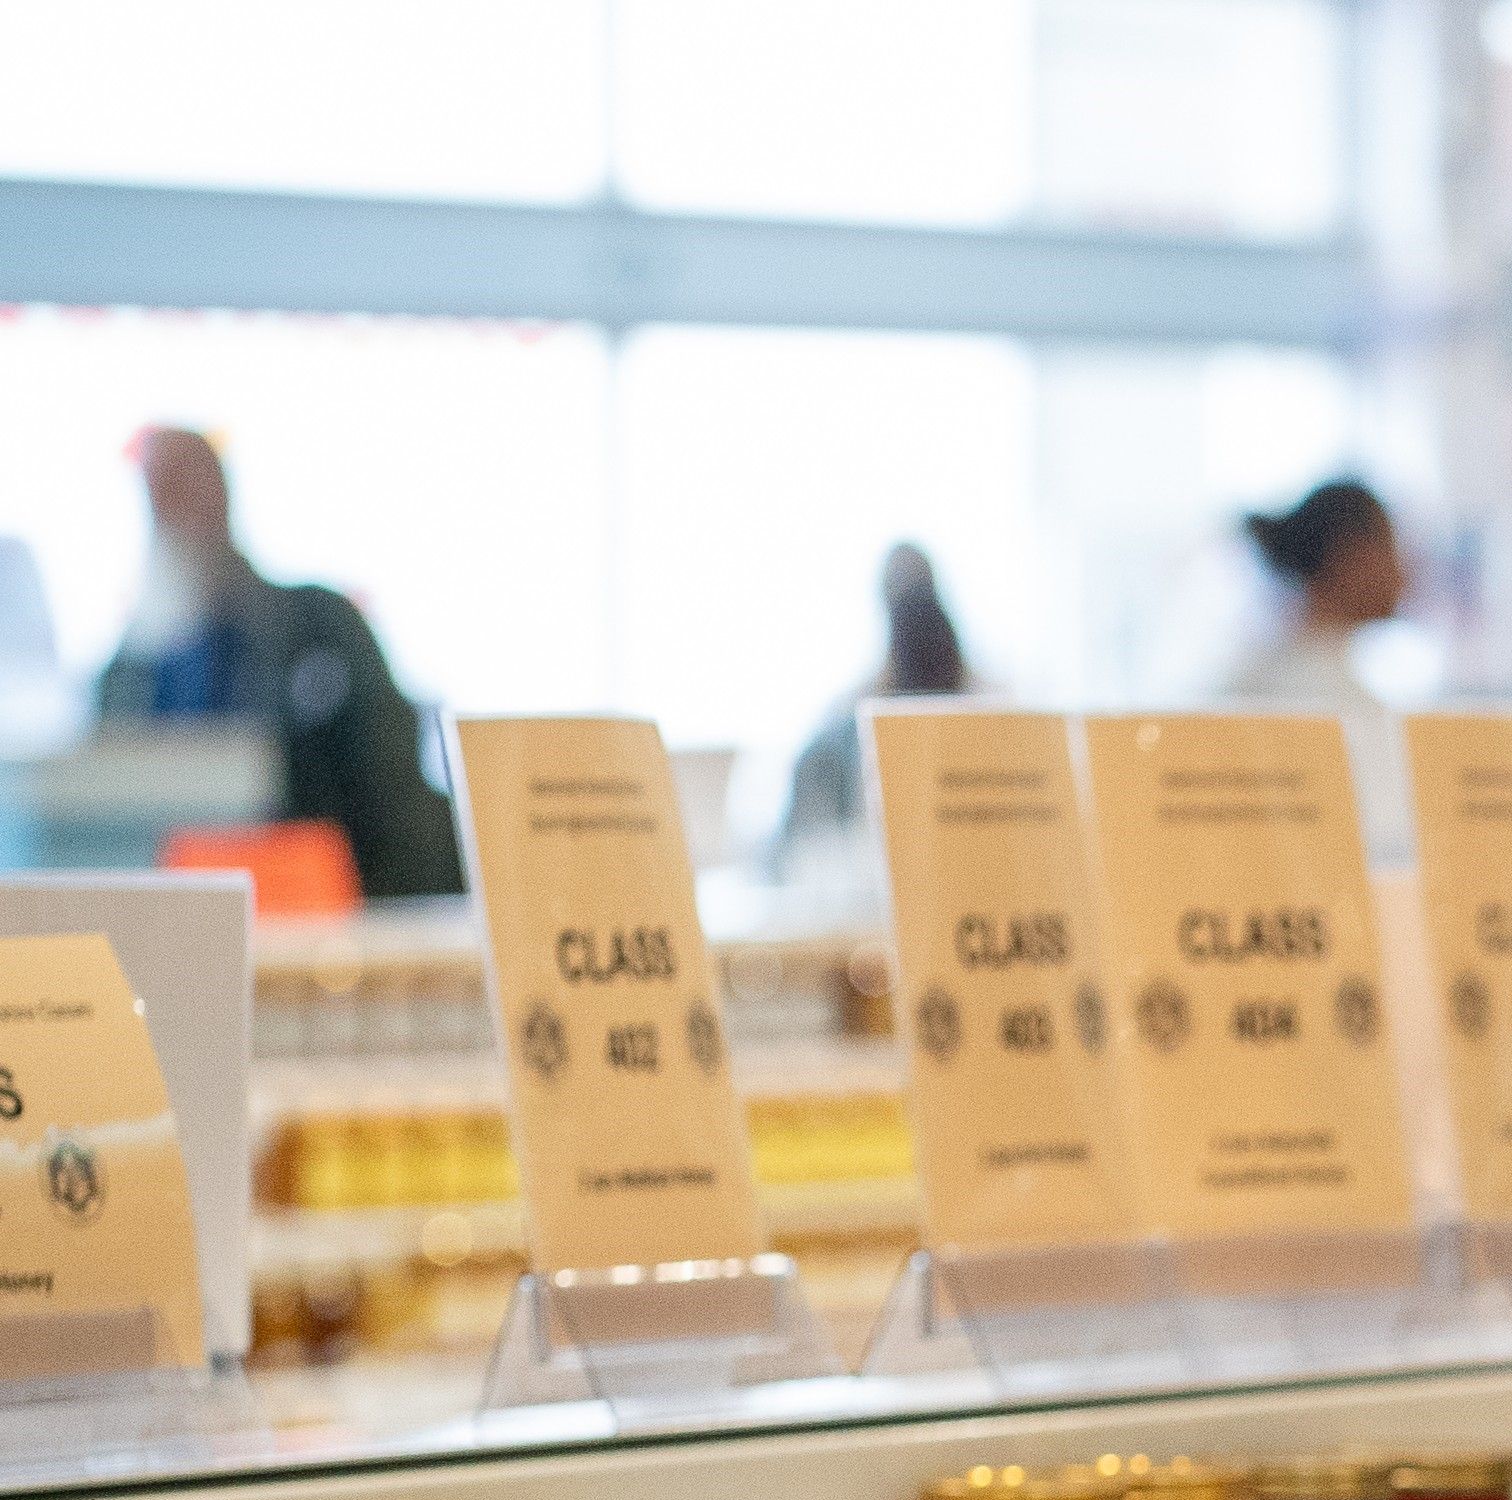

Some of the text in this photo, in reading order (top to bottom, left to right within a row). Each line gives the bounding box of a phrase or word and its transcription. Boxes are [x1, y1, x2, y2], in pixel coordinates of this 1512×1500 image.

[556, 928, 678, 985] CLASS
[955, 912, 1071, 967] CLASS
[1177, 907, 1331, 962] CLASS
